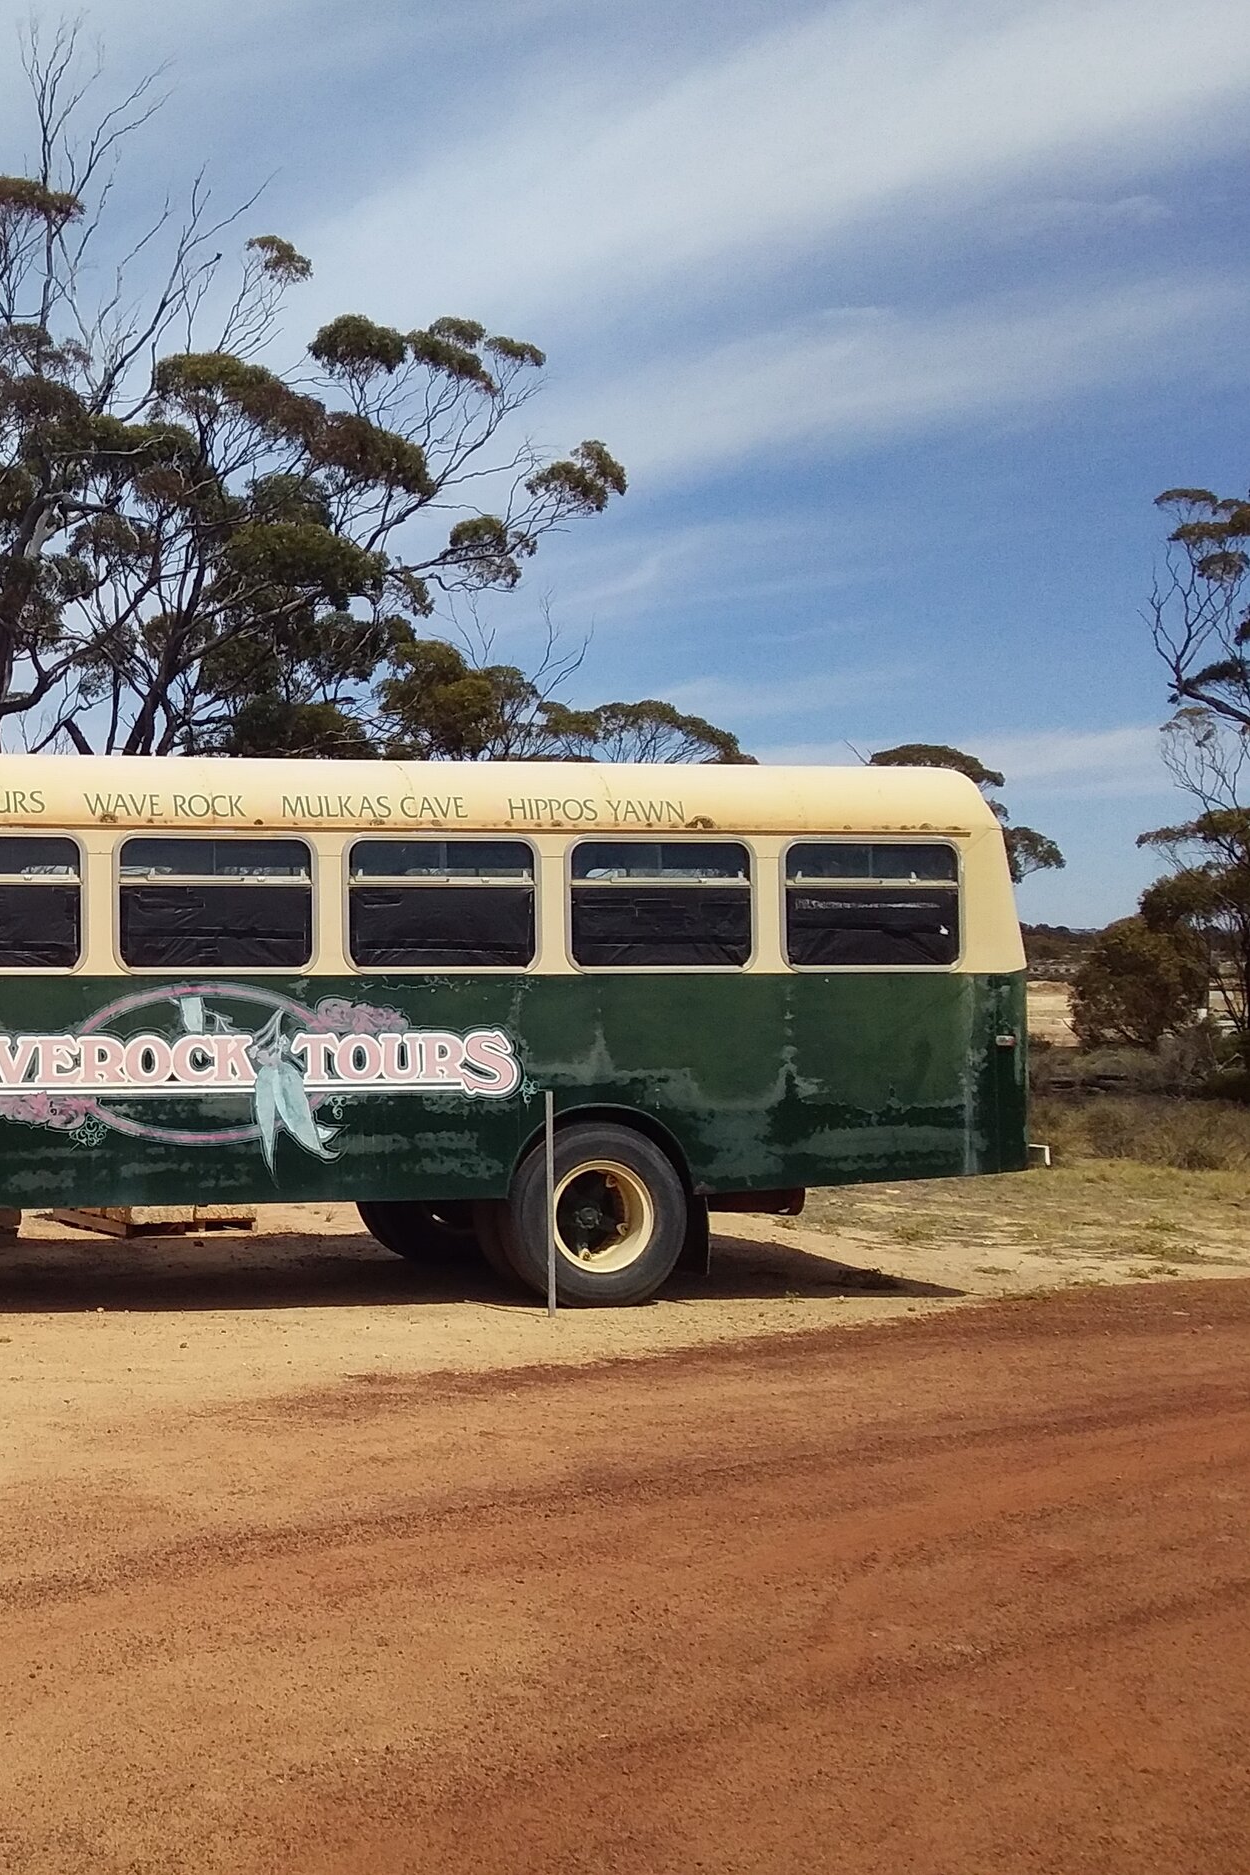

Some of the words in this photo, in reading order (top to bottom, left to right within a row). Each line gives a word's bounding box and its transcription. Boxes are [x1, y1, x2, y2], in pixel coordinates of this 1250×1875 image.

[84, 793, 164, 817] WAVE
[173, 795, 247, 817] ROCK
[281, 796, 392, 818] MULKAS
[400, 796, 469, 818] CAVE
[507, 798, 598, 820] HIPPOS
[606, 800, 686, 822] YAWN
[291, 1028, 519, 1098] TOURS
